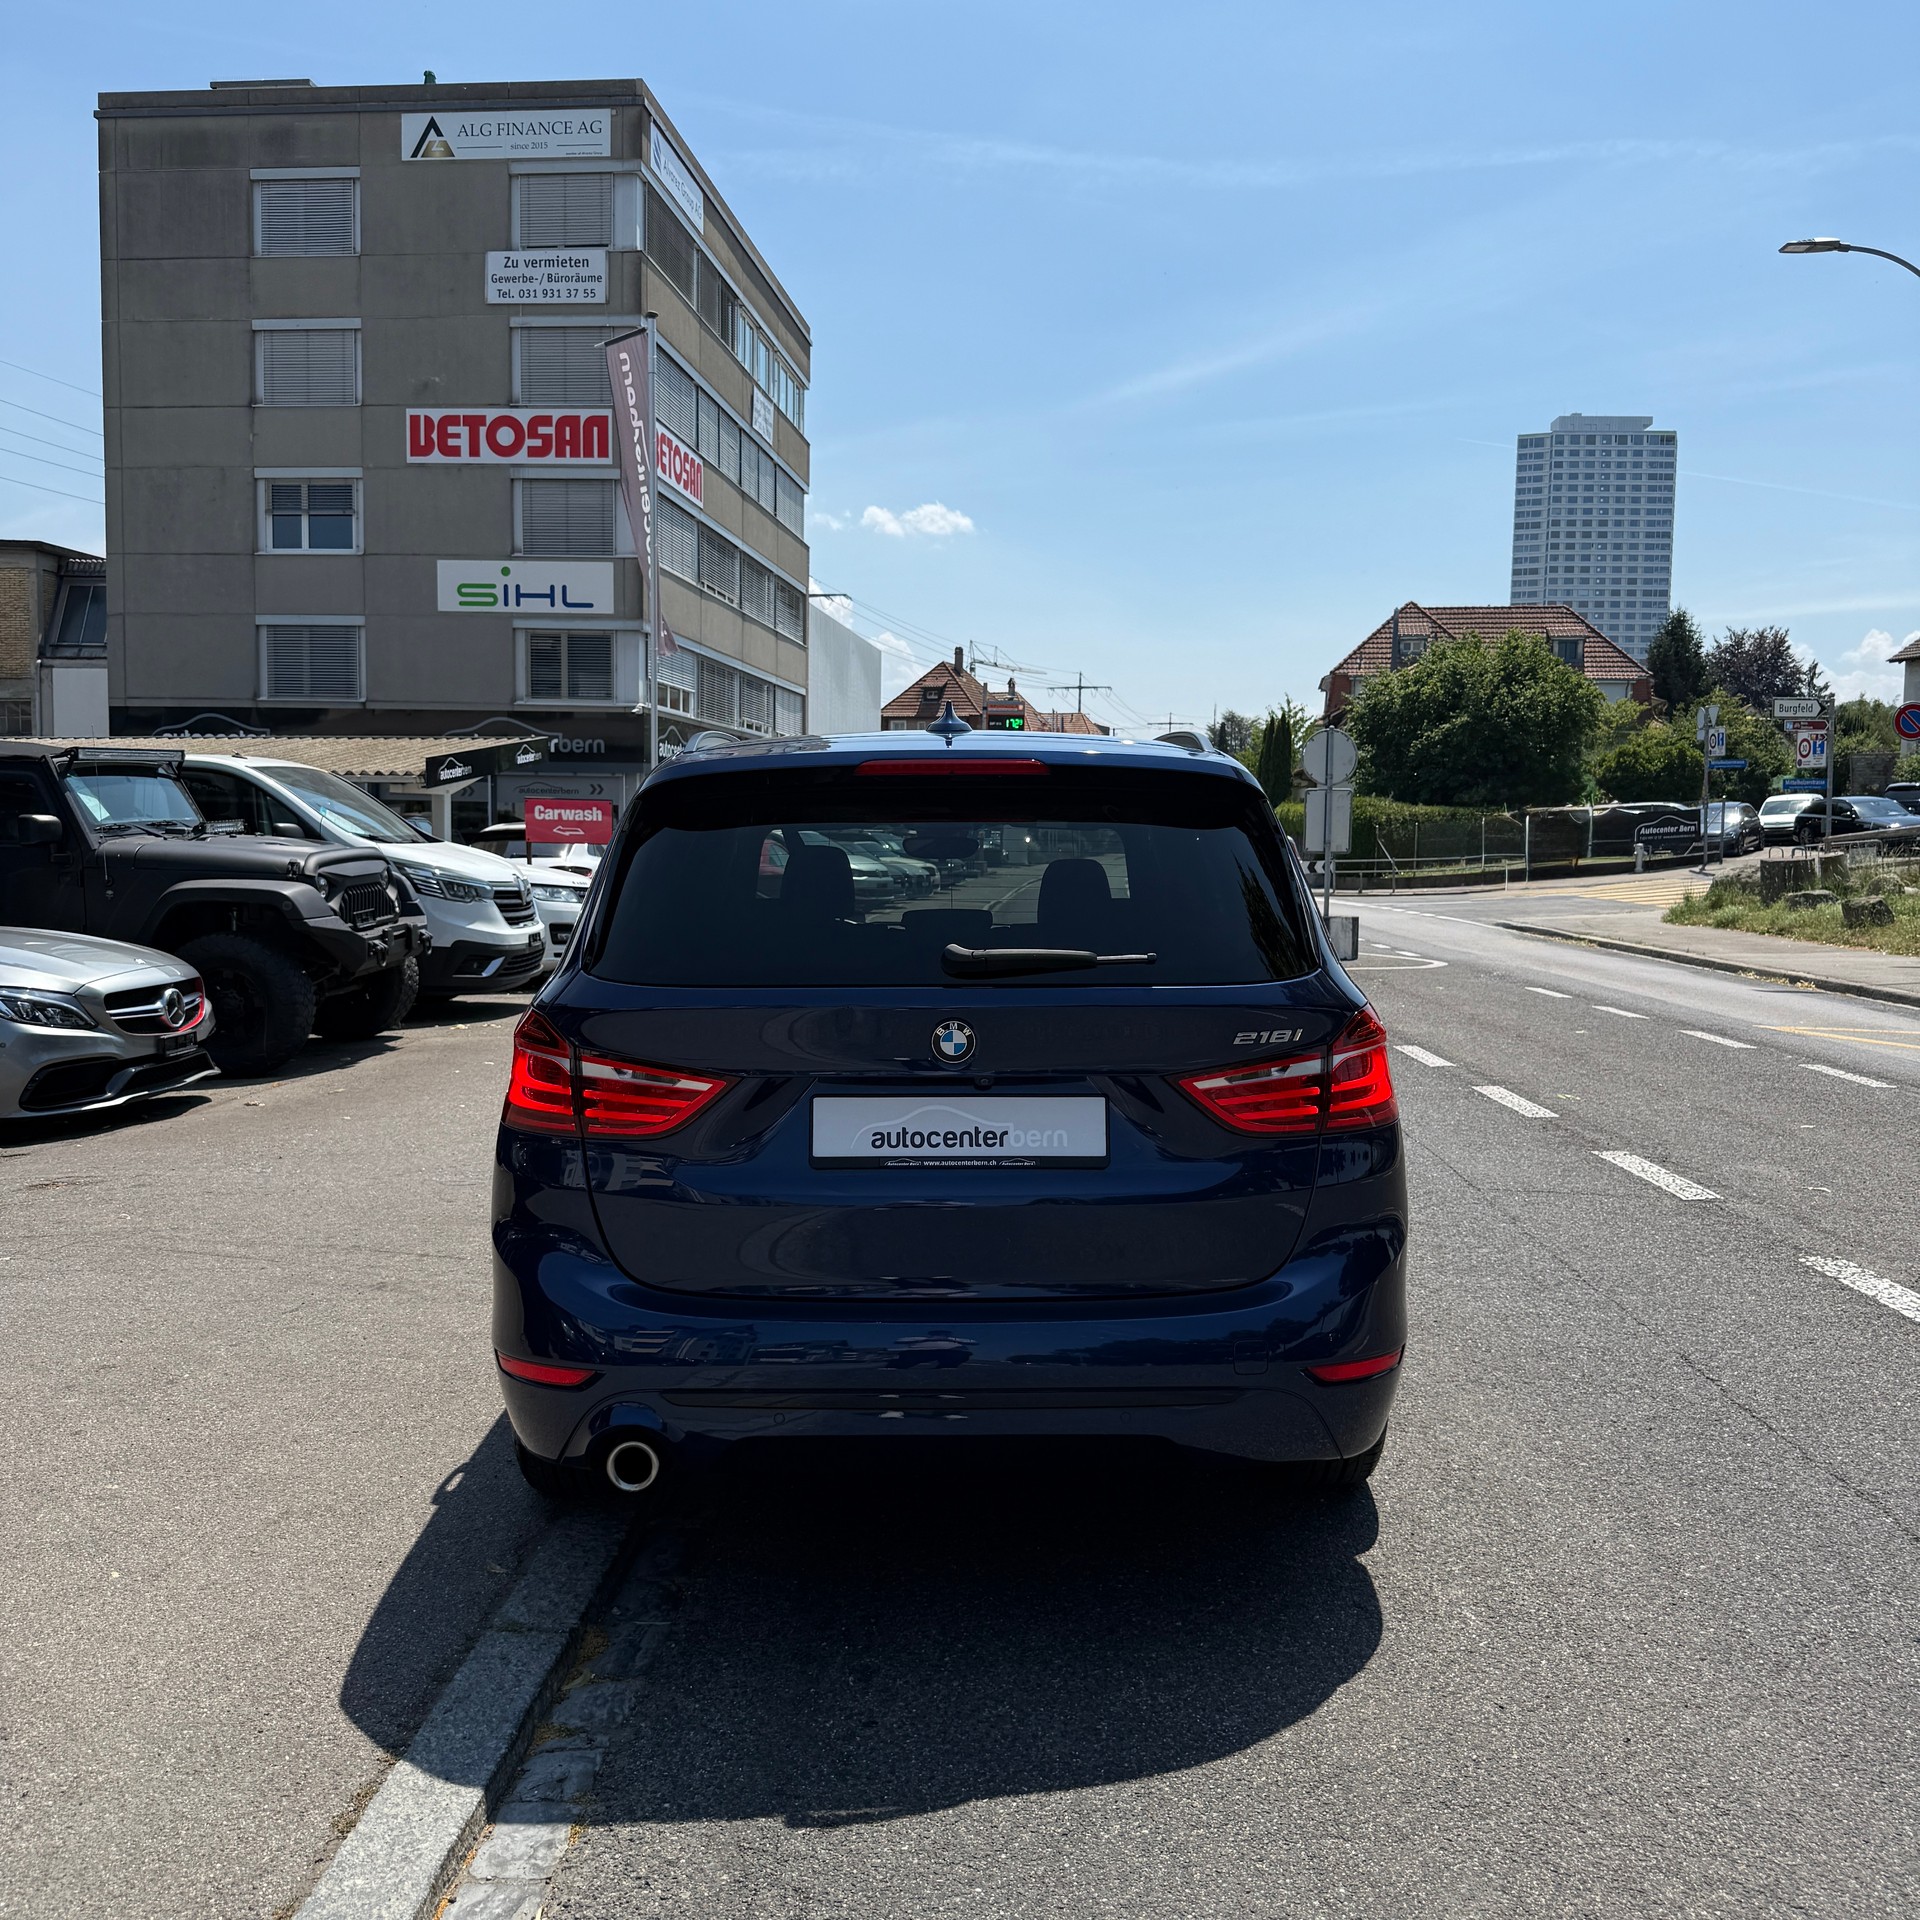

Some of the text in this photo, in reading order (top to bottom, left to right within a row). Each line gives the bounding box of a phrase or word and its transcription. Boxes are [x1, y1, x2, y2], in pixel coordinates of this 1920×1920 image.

[457, 120, 602, 137] ALG FINANCE AG
[510, 141, 549, 150] since 2015
[504, 255, 590, 269] Zu vermieten
[497, 288, 596, 299] Tel. 031 931 37 55
[409, 414, 609, 458] BETOSAN
[1778, 703, 1814, 715] Burgfeld
[518, 786, 580, 795] autocenterbern
[534, 805, 603, 821] Carwash
[1640, 826, 1679, 835] Autocenter
[936, 1022, 972, 1036] BMW
[871, 1126, 1068, 1148] autocenterbern
